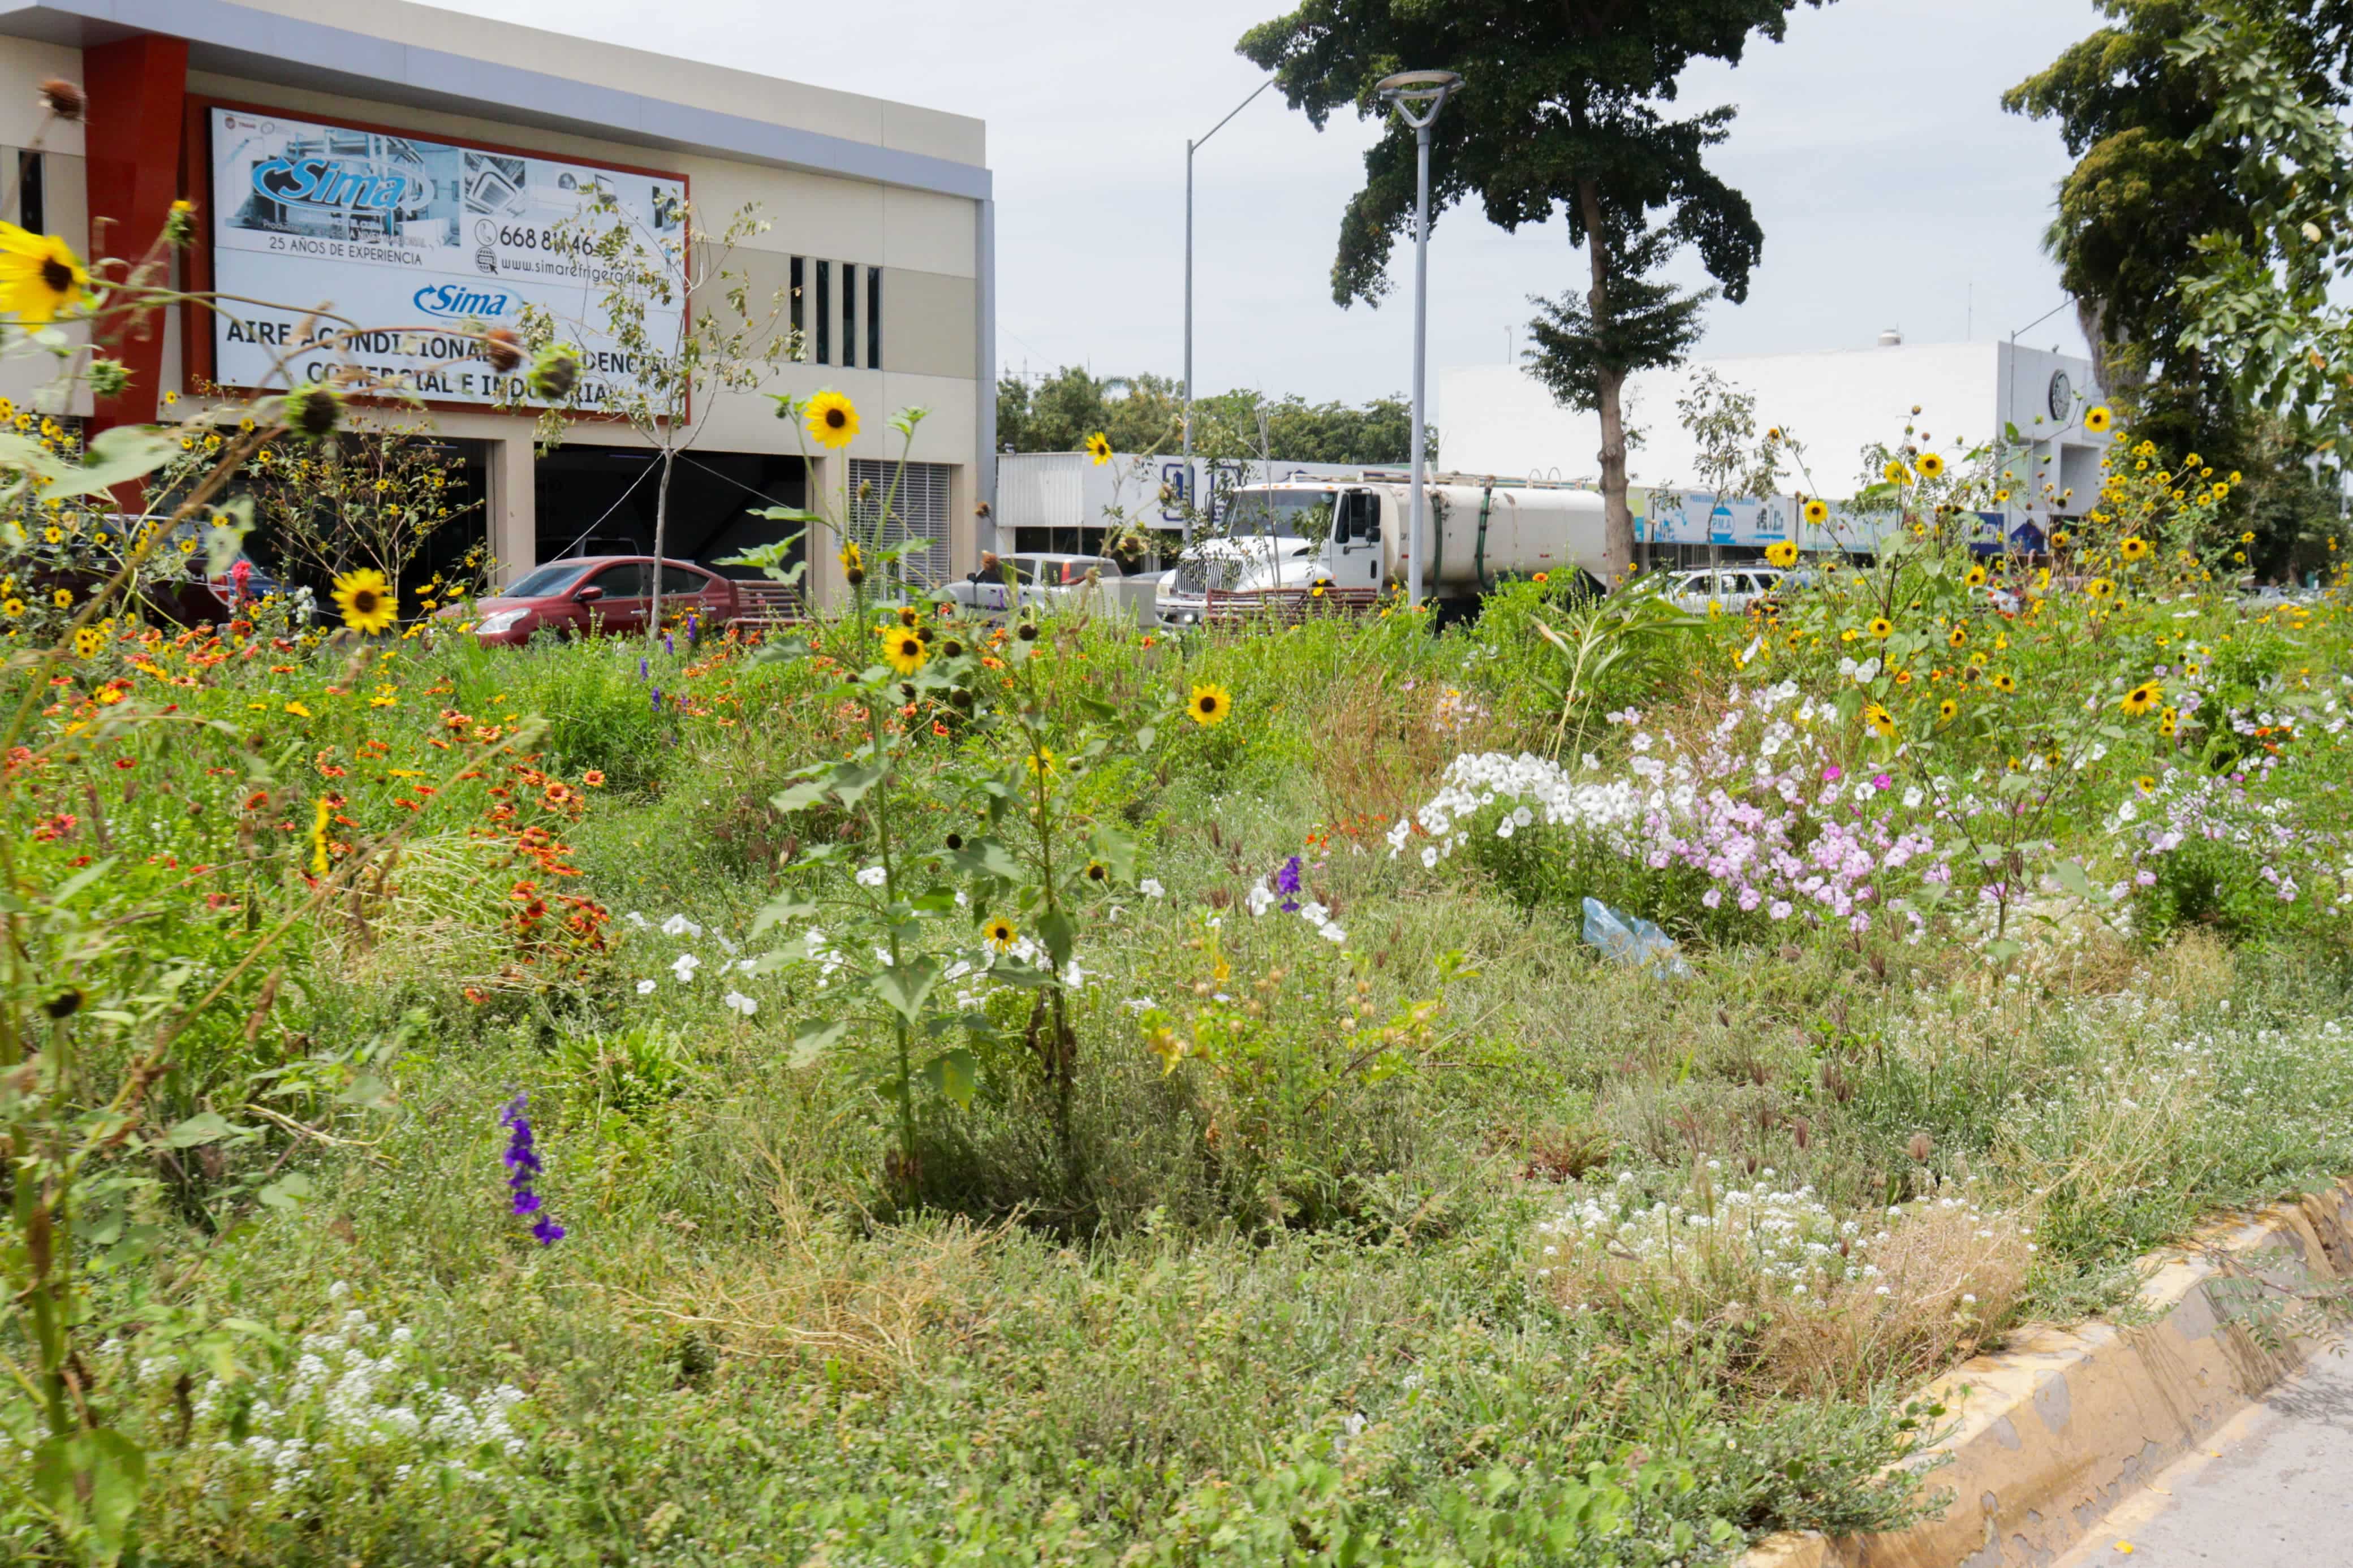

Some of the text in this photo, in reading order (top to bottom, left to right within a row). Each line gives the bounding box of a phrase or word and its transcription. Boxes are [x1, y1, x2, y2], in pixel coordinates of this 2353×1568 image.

[278, 158, 407, 209] Sima
[269, 236, 423, 266] 25 AÑOS DE EXPERIENCIA
[500, 226, 536, 249] 668
[571, 235, 594, 255] 46
[429, 284, 507, 316] Sima
[226, 319, 292, 345] AIRE
[461, 373, 474, 394] E
